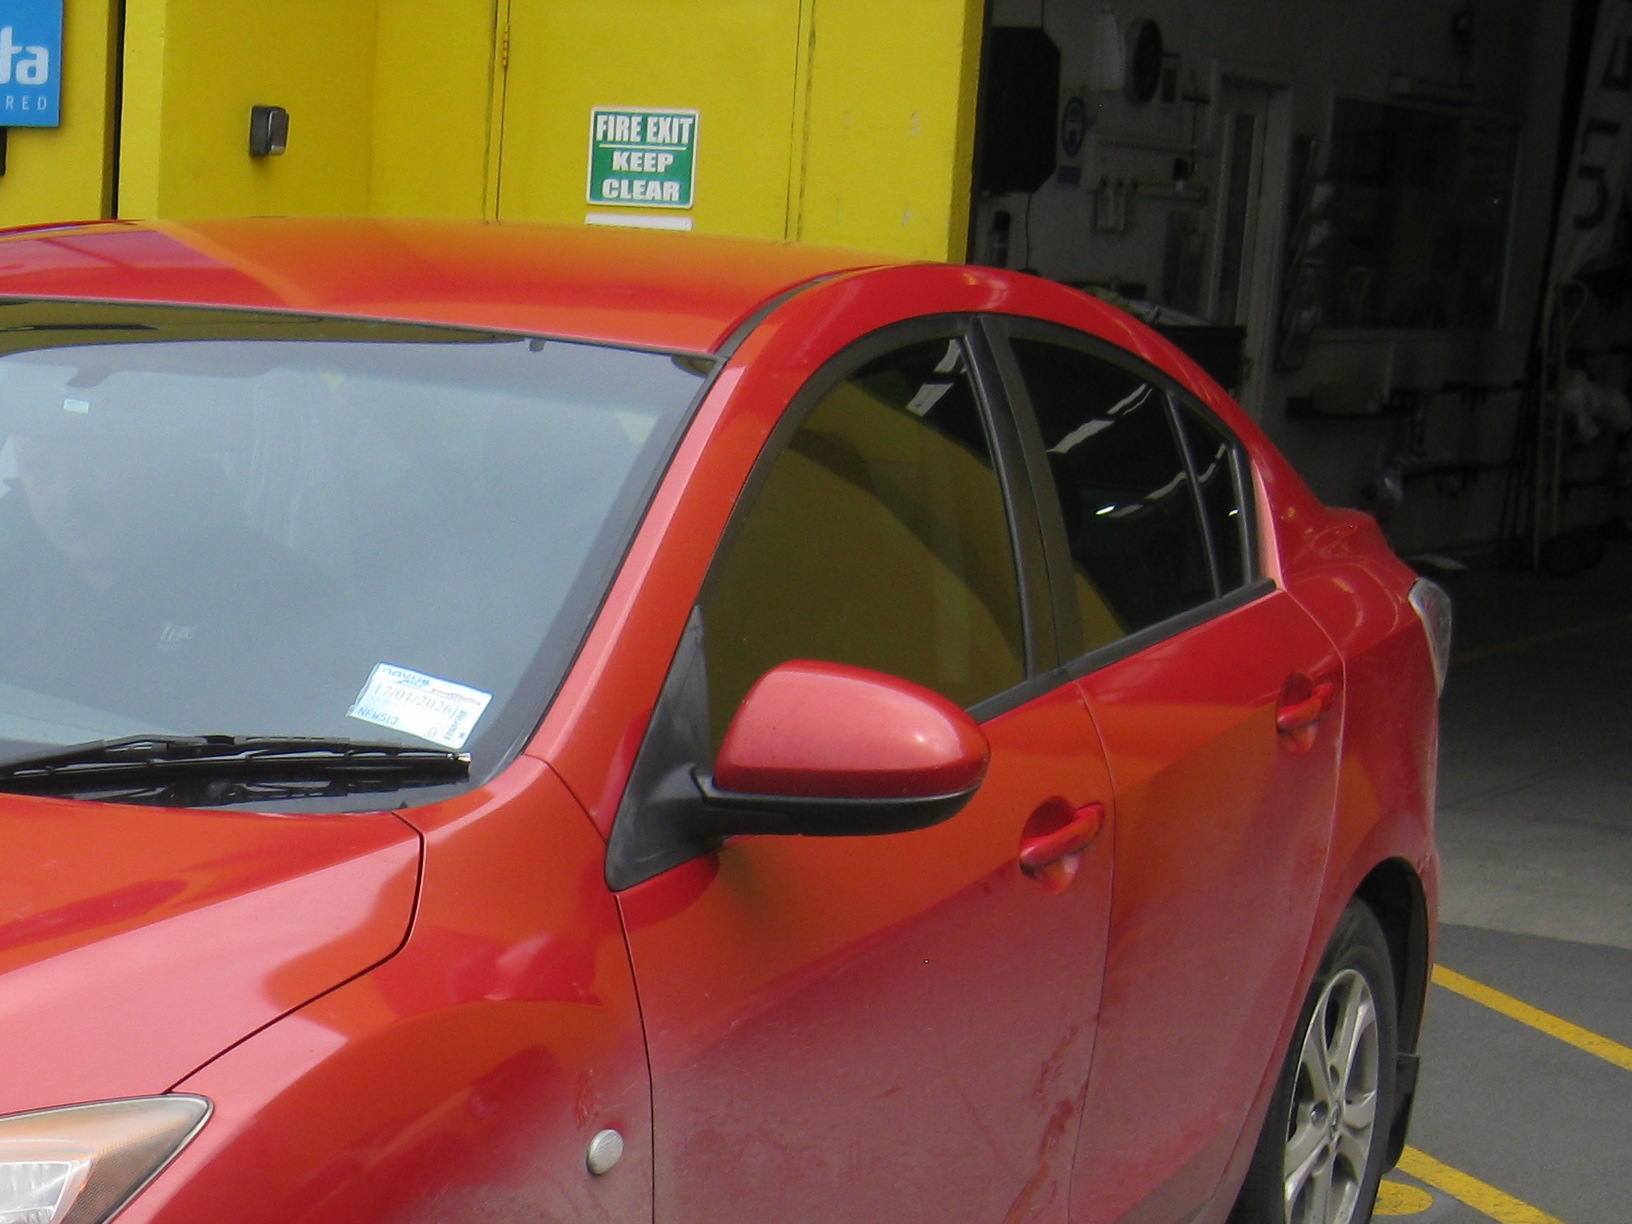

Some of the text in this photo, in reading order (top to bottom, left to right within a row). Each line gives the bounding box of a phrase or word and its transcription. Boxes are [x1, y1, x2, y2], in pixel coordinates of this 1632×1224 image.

[596, 114, 694, 145] FIRE EXIT
[612, 151, 674, 173] KEEP
[601, 178, 681, 202] CLEAR
[374, 683, 453, 716] 17/01/2026
